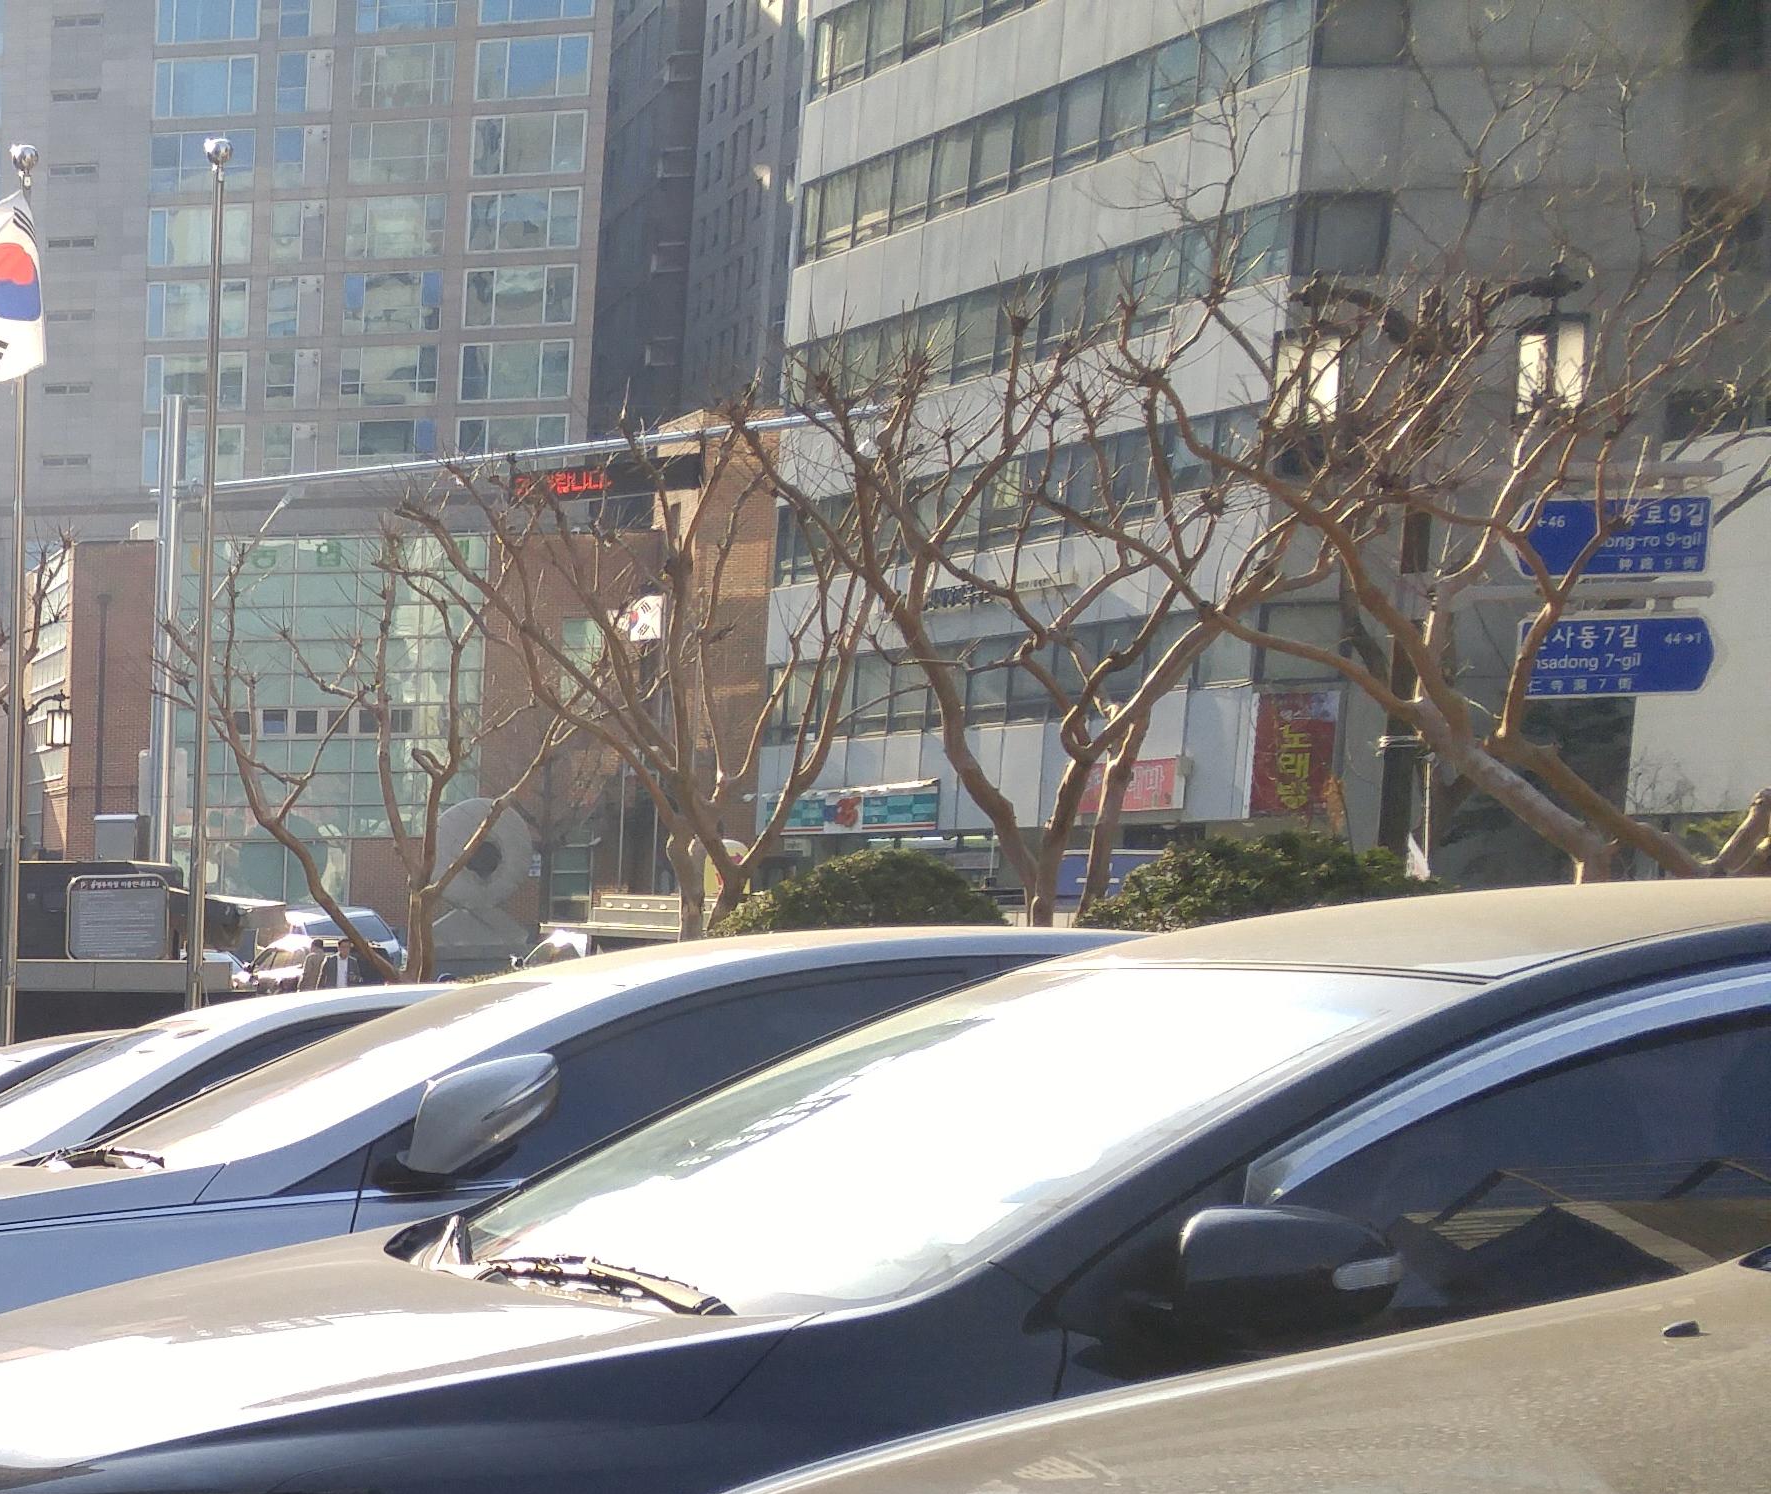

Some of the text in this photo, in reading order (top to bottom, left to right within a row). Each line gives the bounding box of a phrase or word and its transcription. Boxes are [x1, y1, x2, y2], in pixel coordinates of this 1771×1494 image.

[1600, 531, 1703, 551] ong-ro 9-gil
[1533, 652, 1642, 671] nsadong 7-gil
[1279, 723, 1312, 809] 노래방
